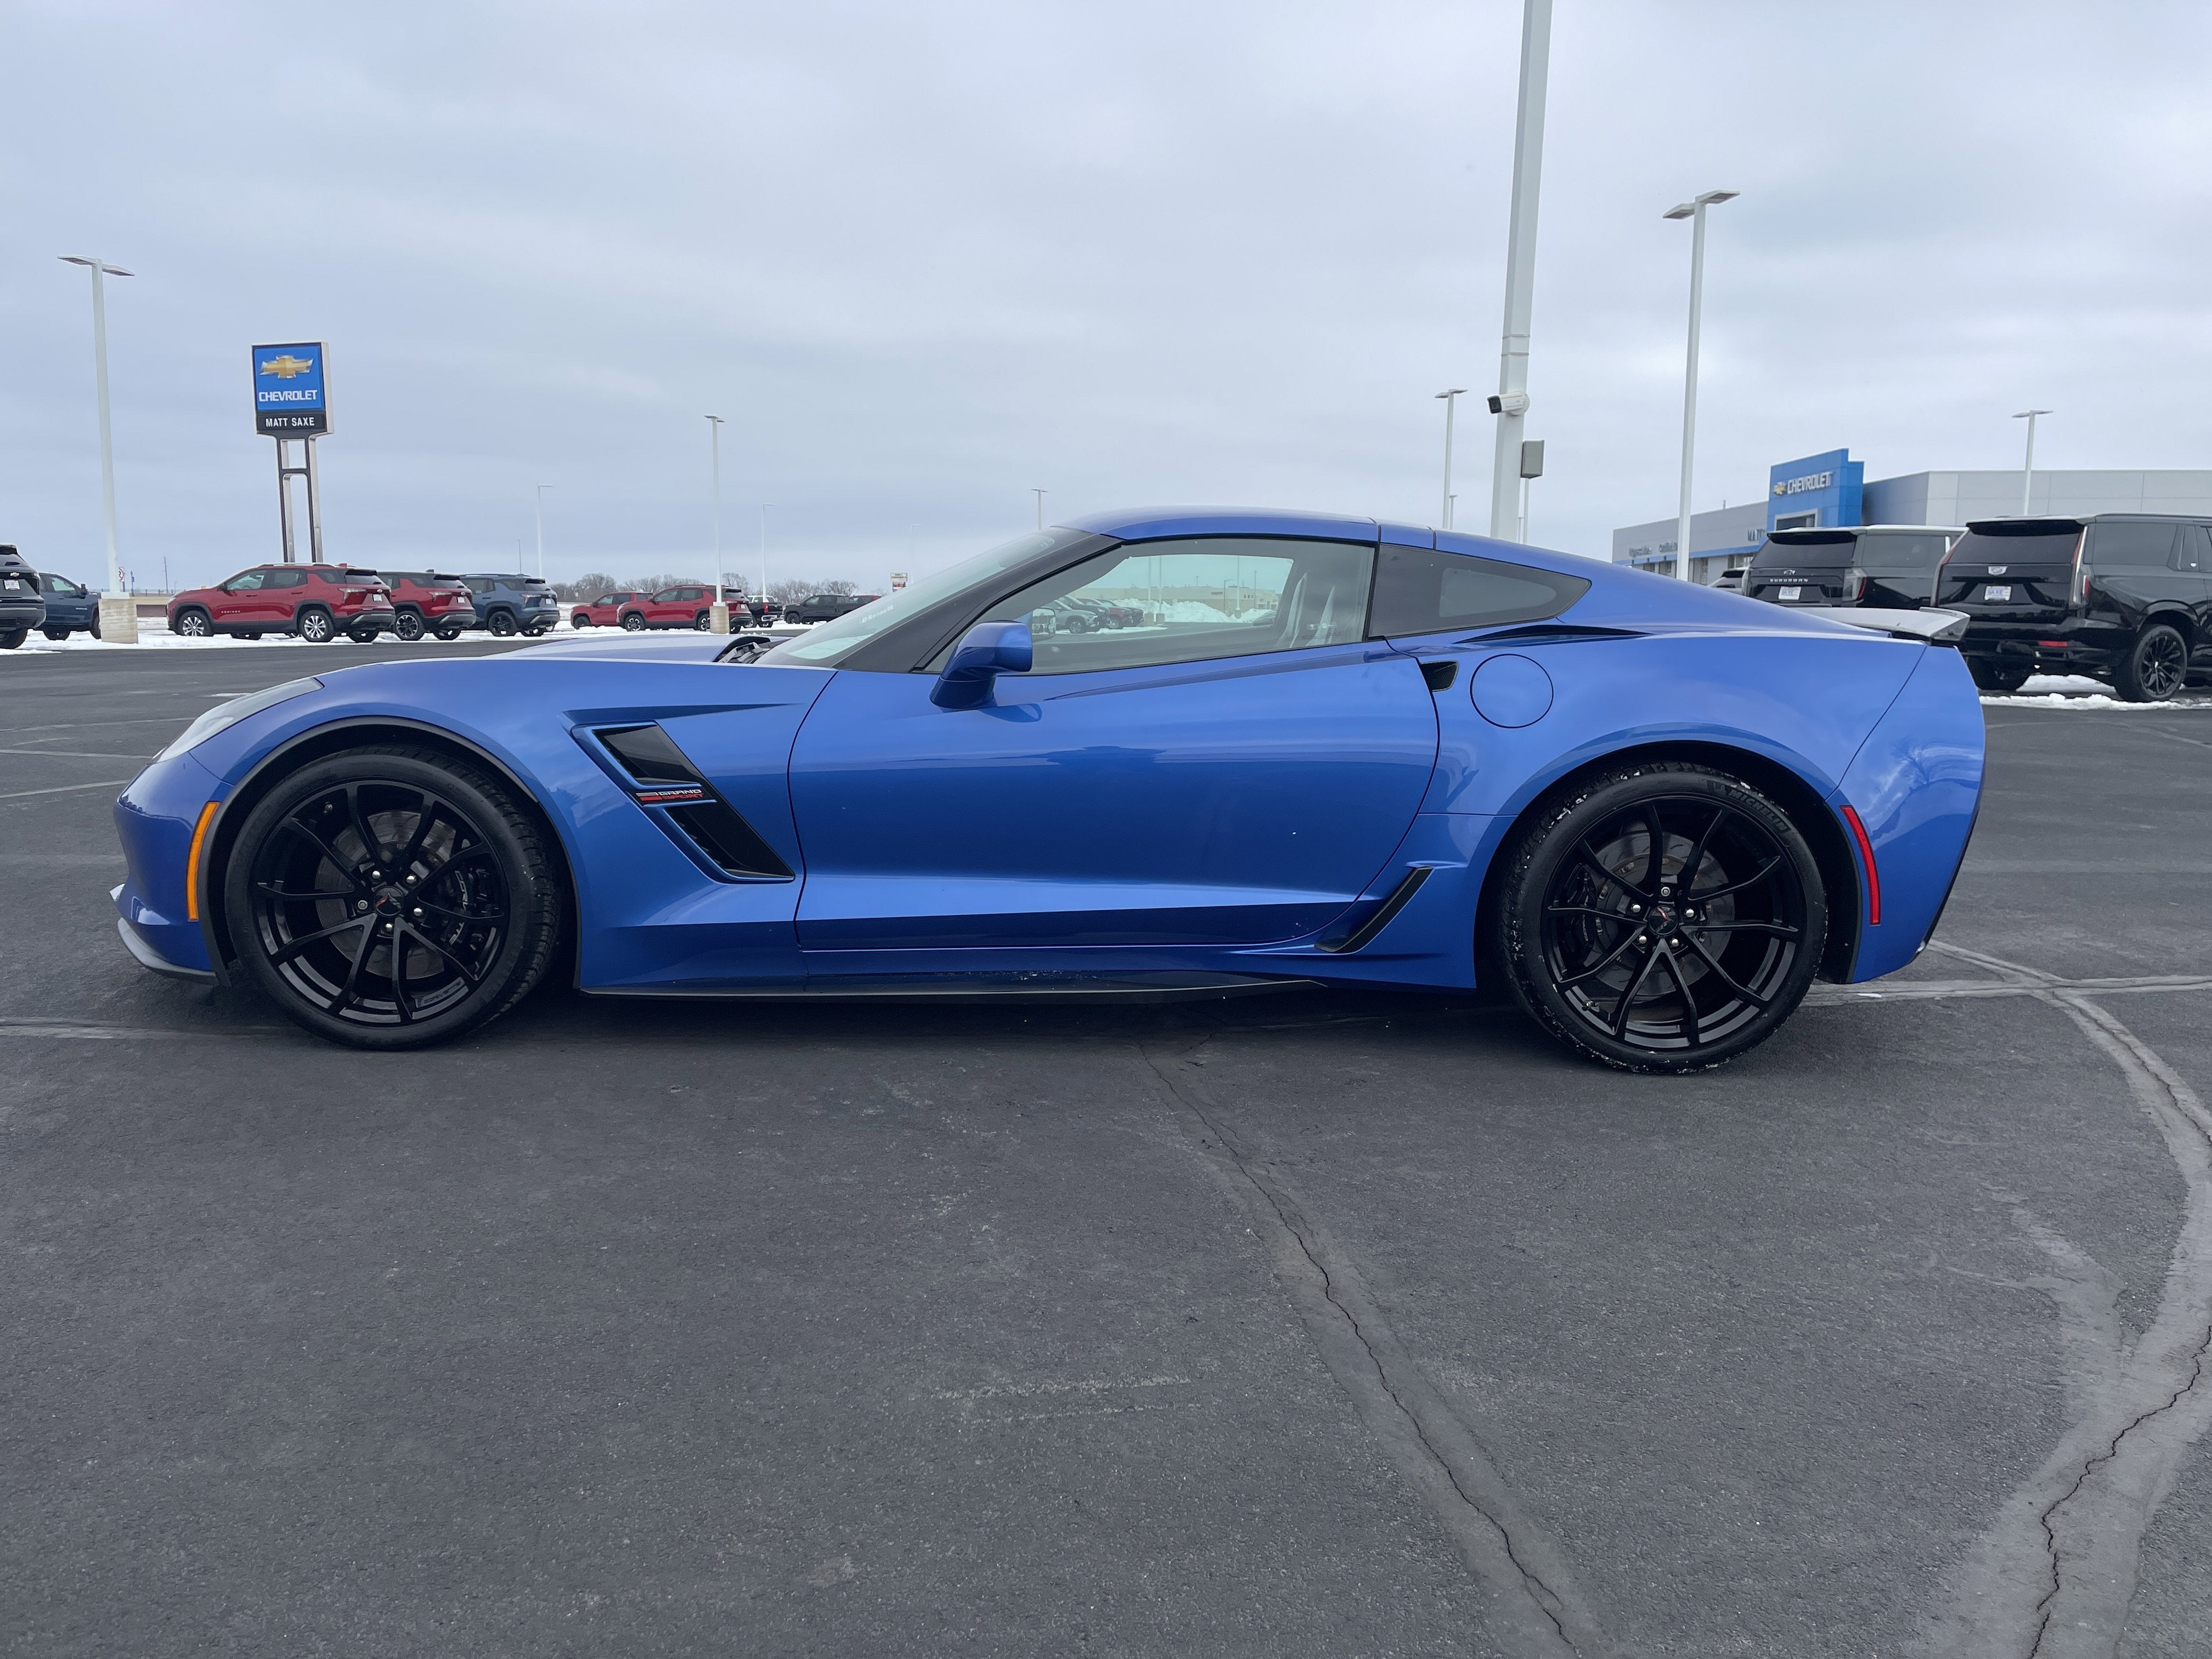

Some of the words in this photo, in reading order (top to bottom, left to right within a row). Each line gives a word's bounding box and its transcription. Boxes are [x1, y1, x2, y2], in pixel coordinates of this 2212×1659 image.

[258, 390, 317, 402] CHEVROLET
[266, 417, 288, 427] MATT
[291, 417, 315, 426] SAXE
[1787, 471, 1832, 494] CHEVROLET
[1728, 789, 1787, 831] MICHELIN
